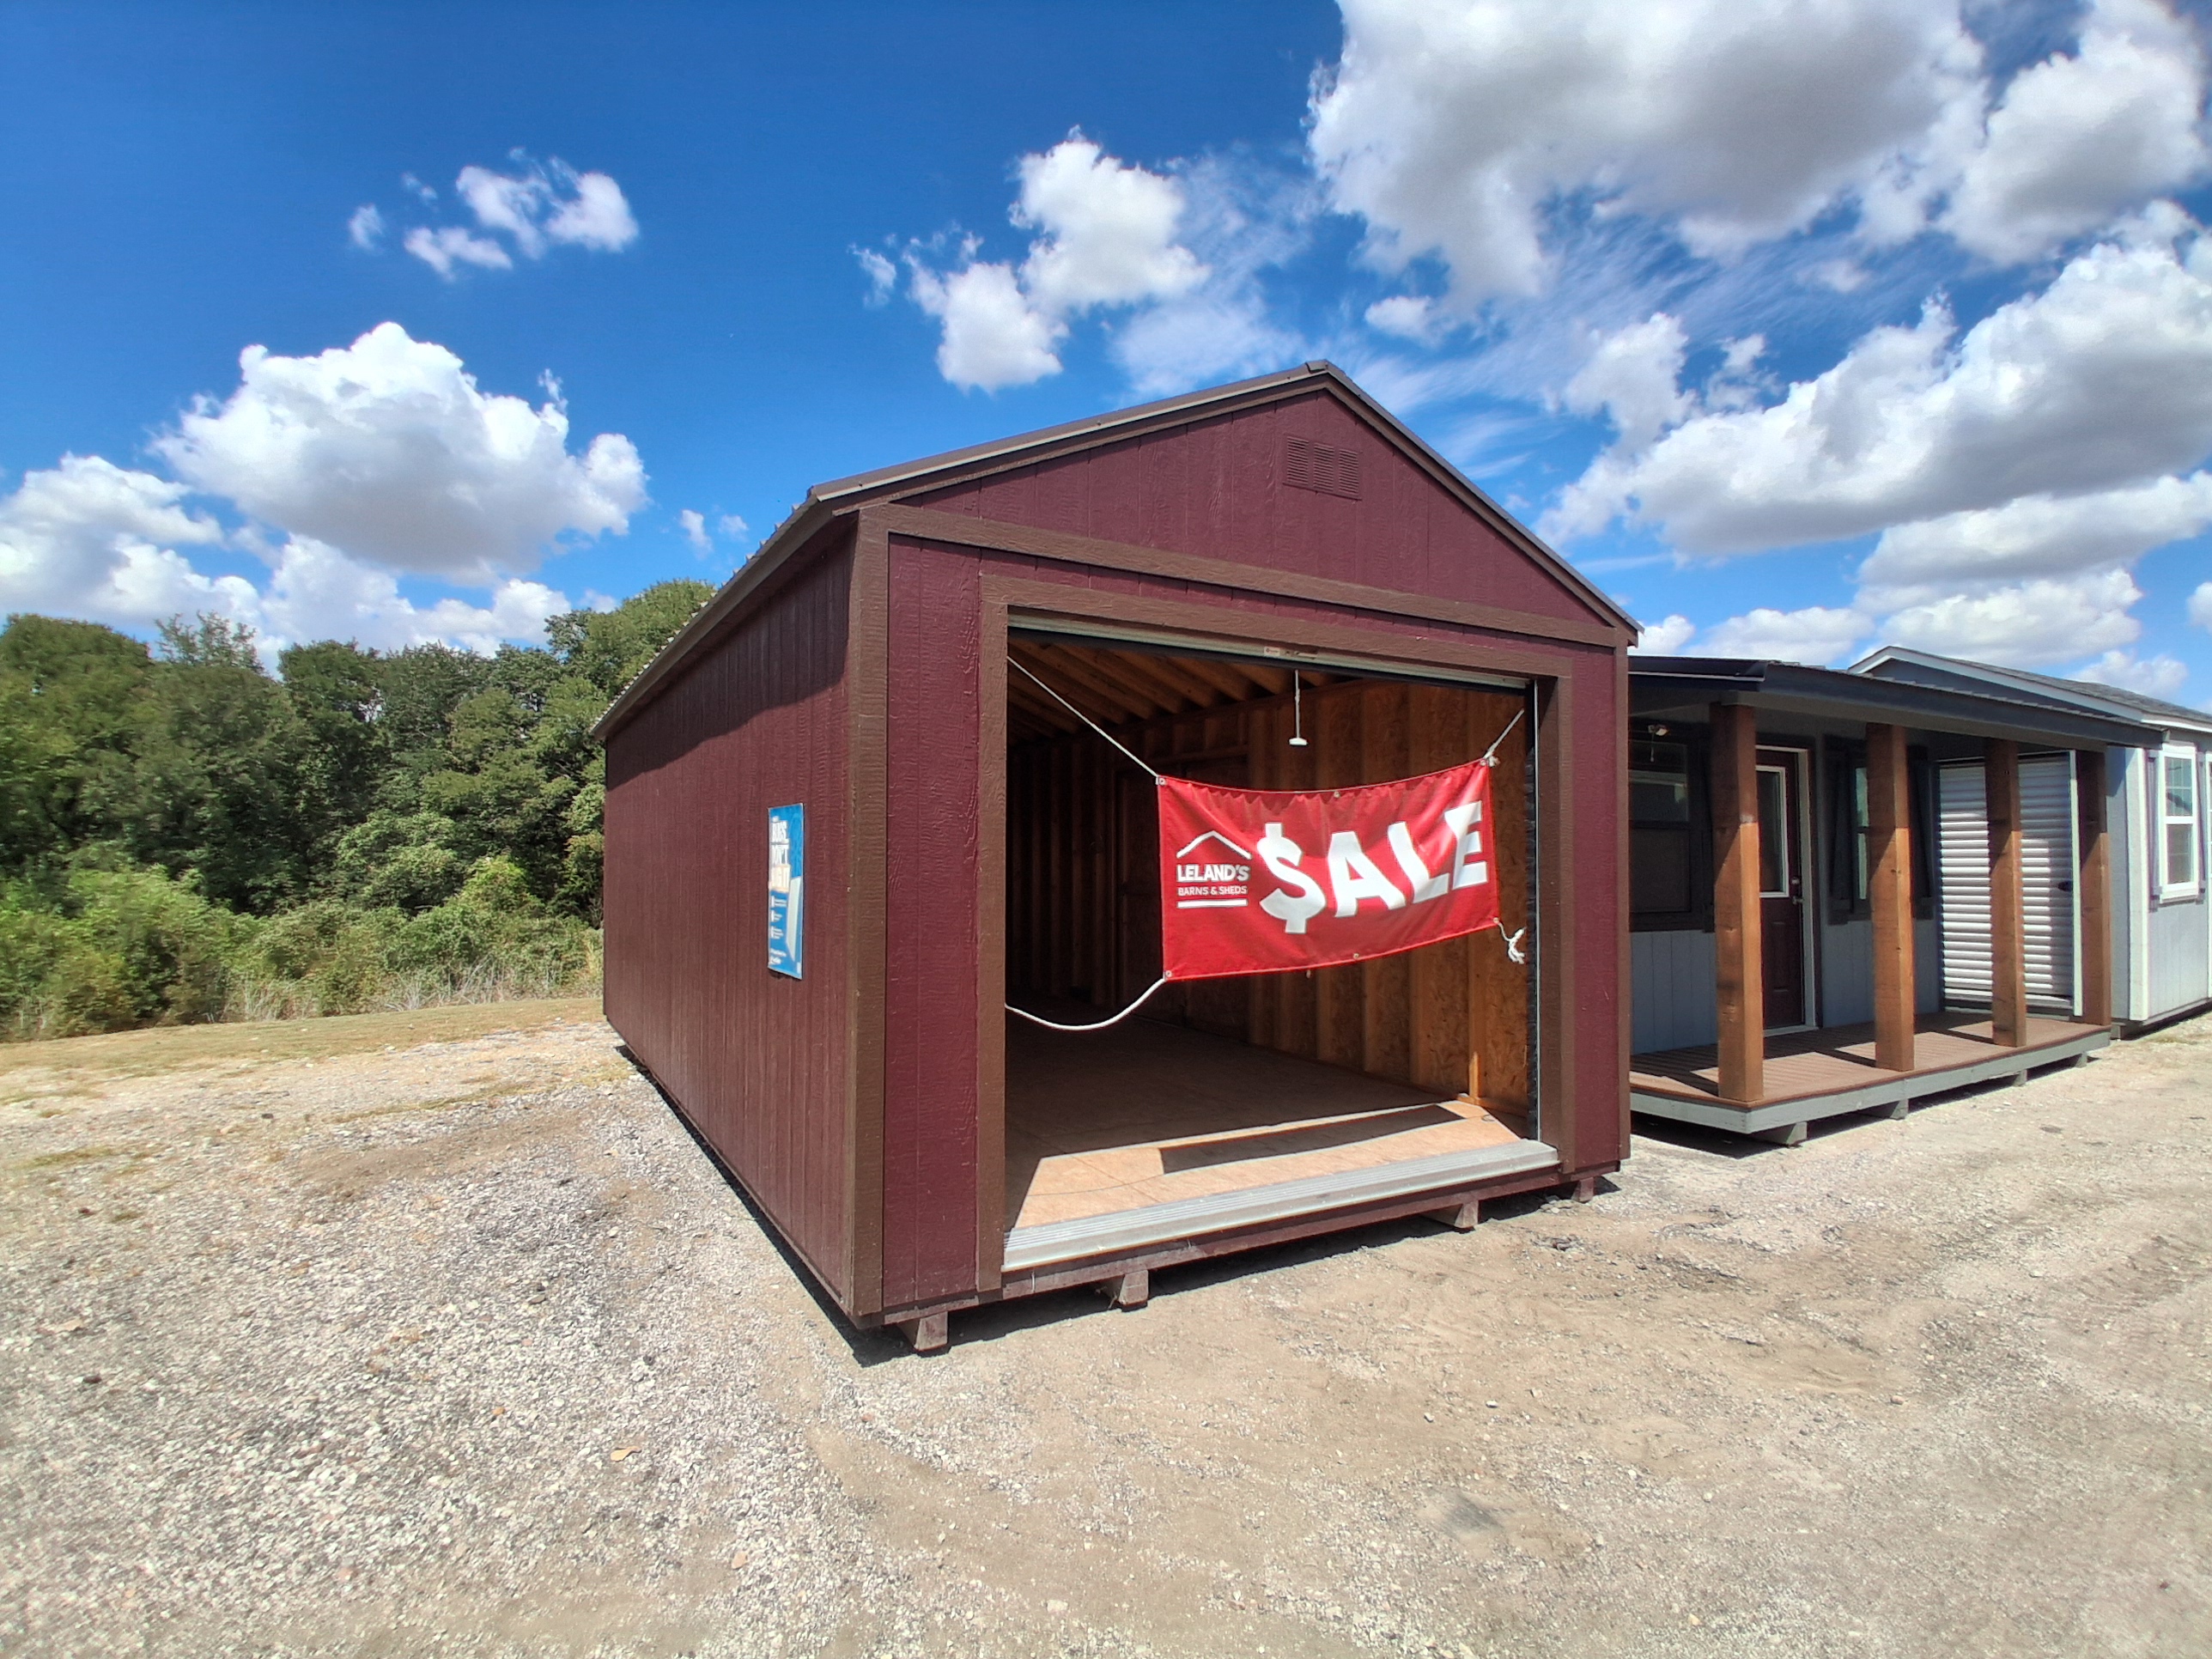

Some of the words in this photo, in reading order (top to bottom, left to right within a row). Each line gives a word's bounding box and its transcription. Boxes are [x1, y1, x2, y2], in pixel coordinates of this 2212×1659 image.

[1177, 864, 1249, 883] LELAND'S
[1257, 801, 1487, 933] $ALE
[1178, 887, 1208, 896] BARNS
[1210, 886, 1217, 896] &
[1219, 885, 1248, 895] SHEDS
